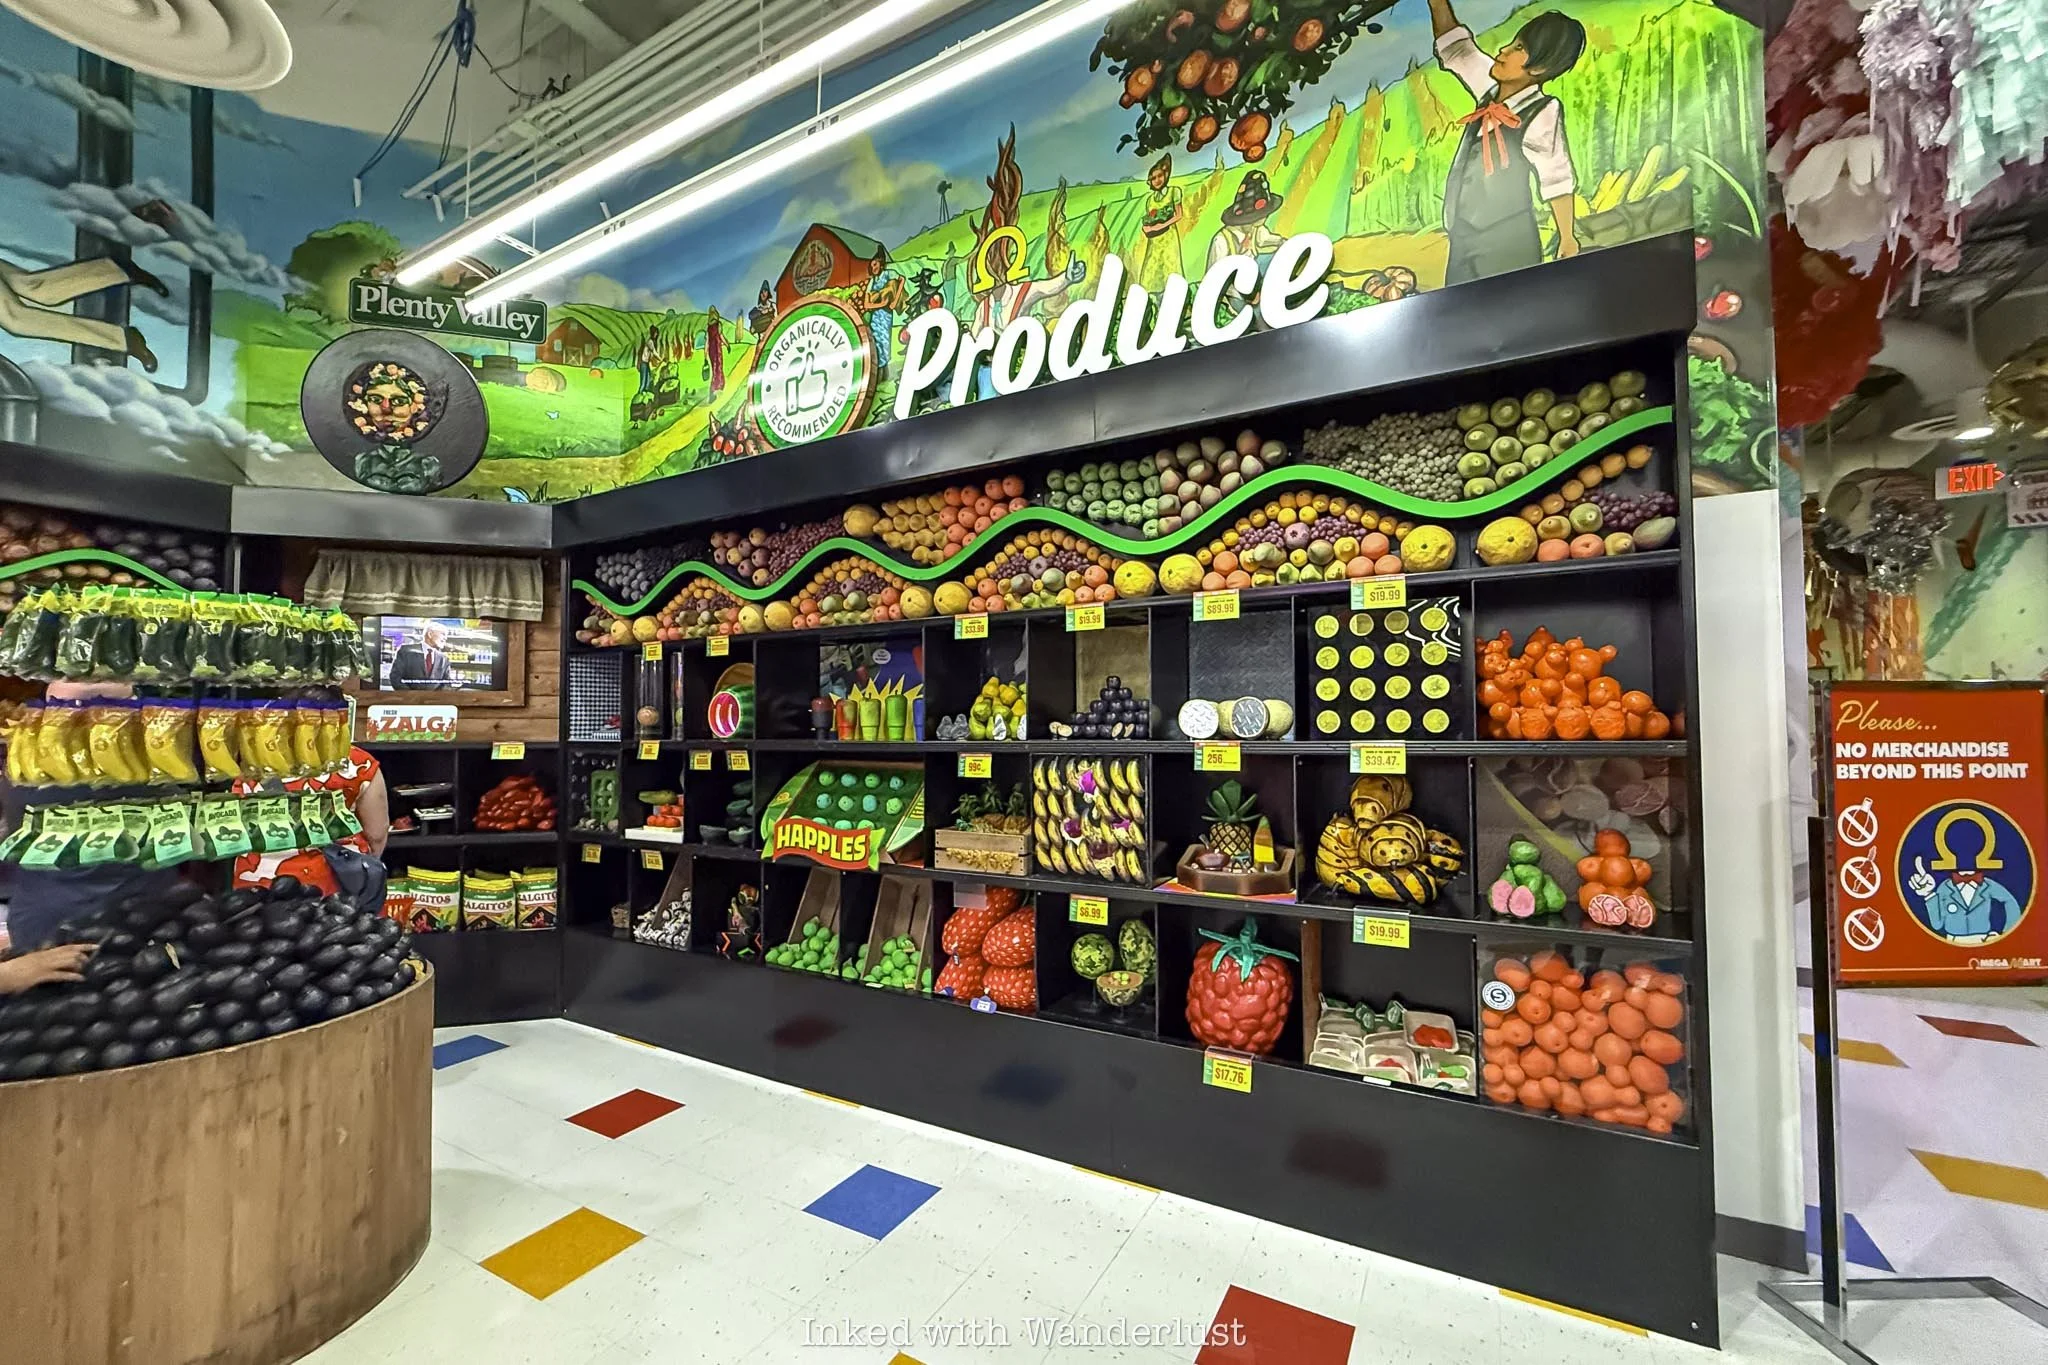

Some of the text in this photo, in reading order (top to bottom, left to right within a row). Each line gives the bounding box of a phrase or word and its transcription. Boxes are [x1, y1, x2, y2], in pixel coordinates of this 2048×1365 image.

[356, 285, 540, 339] Plenty Valley
[893, 231, 1334, 420] Produce
[769, 320, 846, 372] ORGANICALLY
[768, 385, 847, 438] RECOMMENDED
[1948, 463, 1998, 494] EXIT
[1370, 590, 1400, 601] $19.99
[1207, 603, 1234, 614] $89.99
[1836, 700, 1937, 731] Please...
[1836, 742, 2009, 758] NO MERCHANDISE
[1207, 754, 1223, 764] 256
[1366, 755, 1396, 766] $39.47
[1836, 763, 2029, 779] BEYOND THIS POINT
[208, 809, 238, 821] AVOCADO
[777, 824, 866, 861] HAPPLES
[1369, 925, 1400, 939] $19.99
[1215, 1068, 1244, 1084] $17.76
